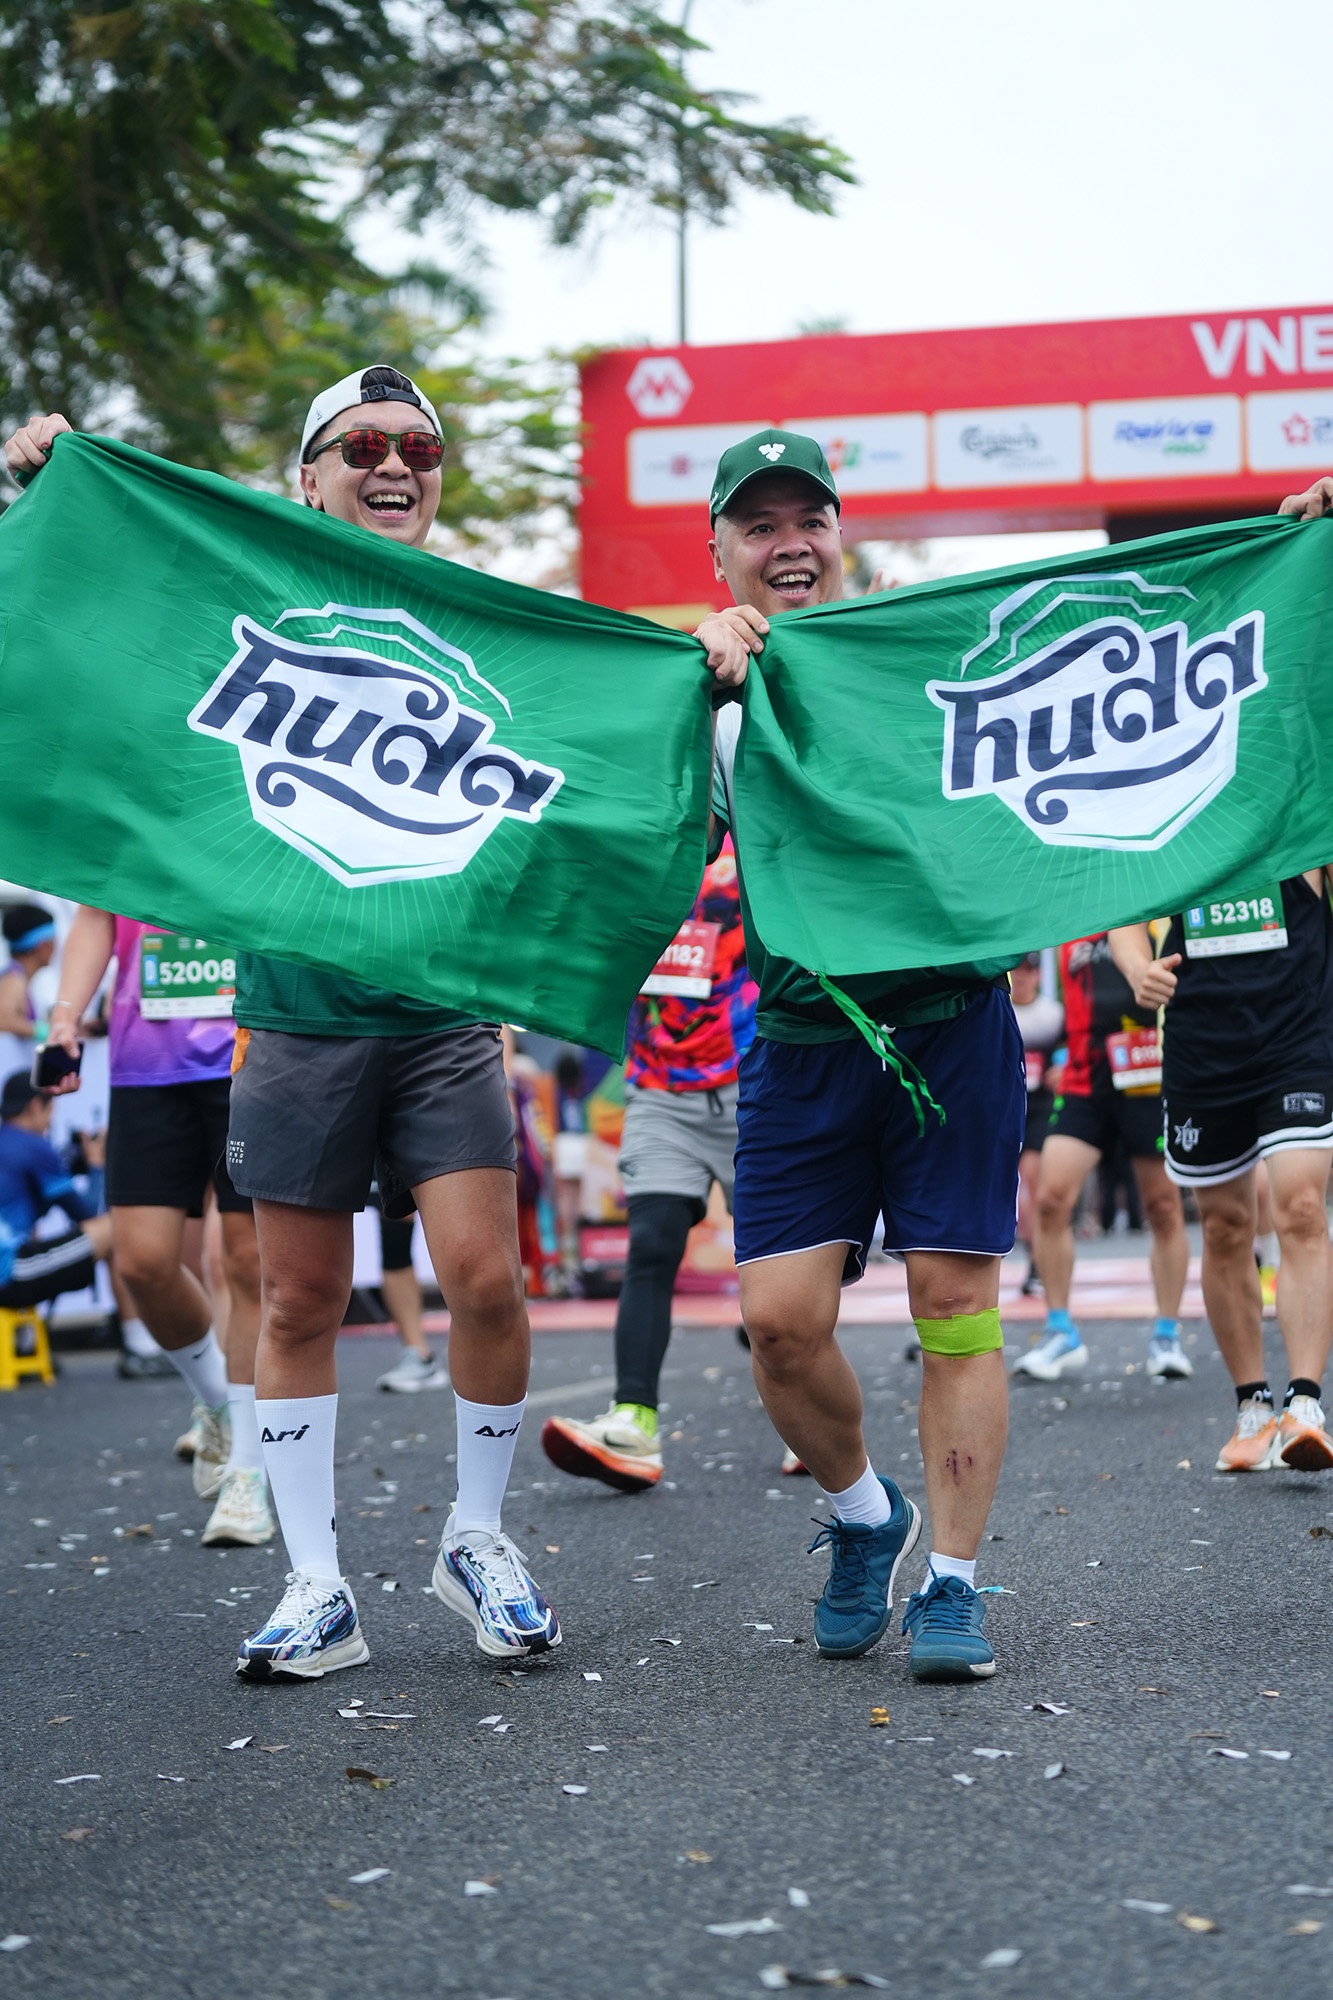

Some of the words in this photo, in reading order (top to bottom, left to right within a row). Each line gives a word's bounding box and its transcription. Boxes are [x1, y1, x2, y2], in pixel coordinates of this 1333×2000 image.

[196, 624, 556, 813] huda
[934, 619, 1259, 792] huda
[1210, 897, 1275, 926] 52318
[160, 957, 236, 985] 52008
[261, 1424, 310, 1443] Ari
